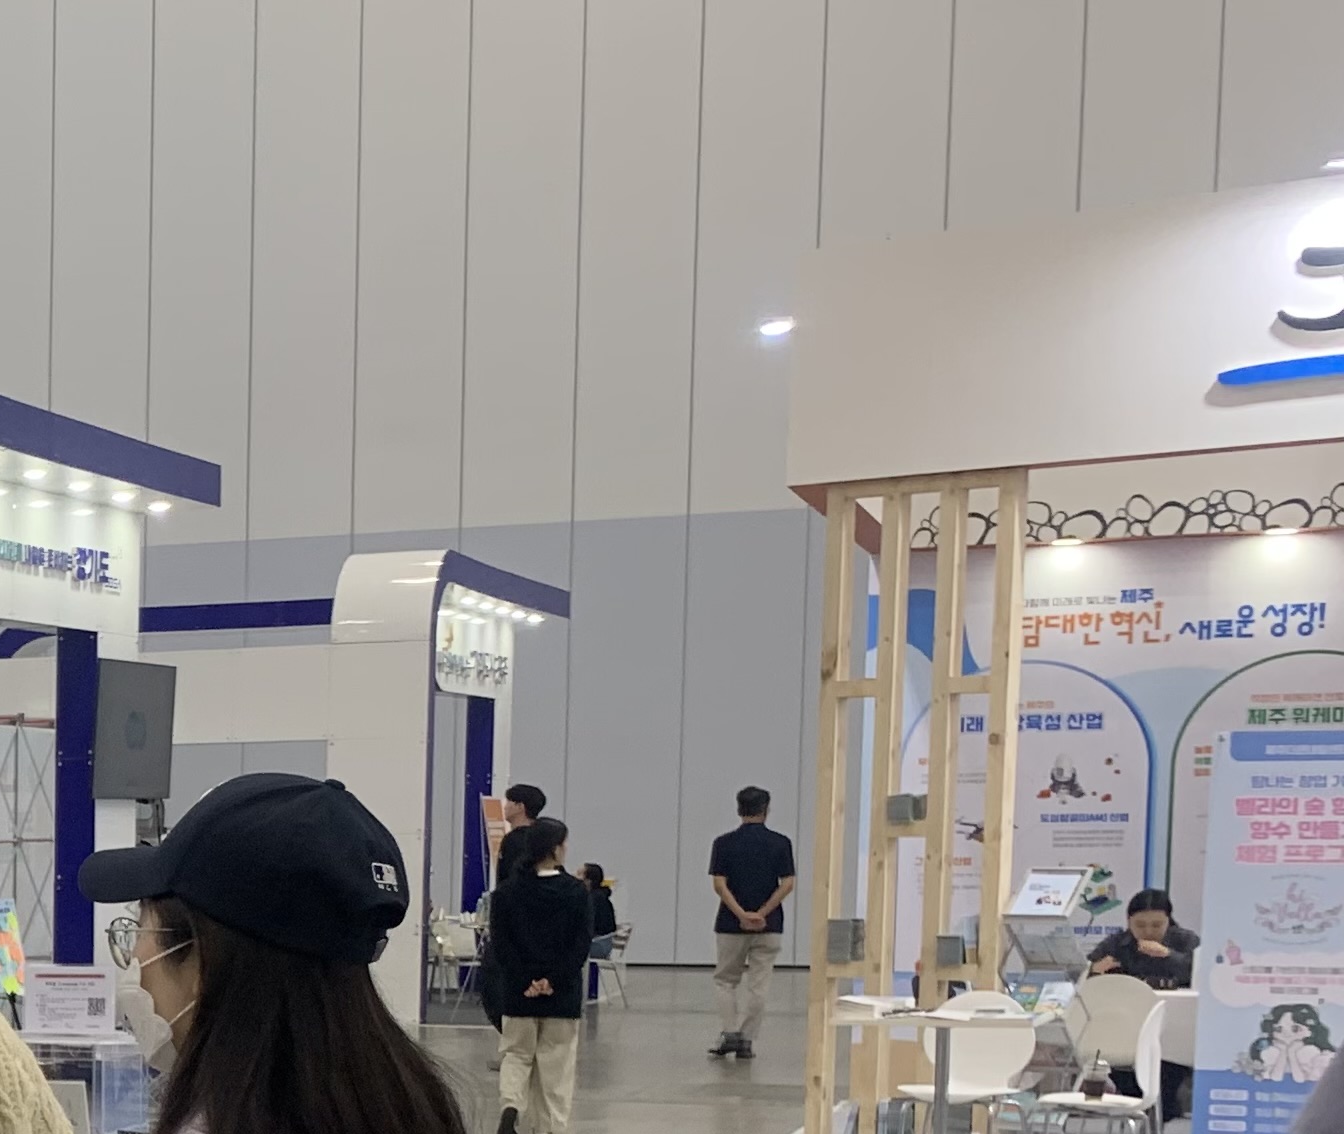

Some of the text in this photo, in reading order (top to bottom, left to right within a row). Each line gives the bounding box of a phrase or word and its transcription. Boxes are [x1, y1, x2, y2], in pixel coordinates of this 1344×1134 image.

[1120, 588, 1154, 604] 제주
[1178, 604, 1255, 641] 새로운
[1261, 602, 1327, 638] 성장!
[1067, 712, 1104, 731] 산업
[1248, 708, 1287, 726] 제주
